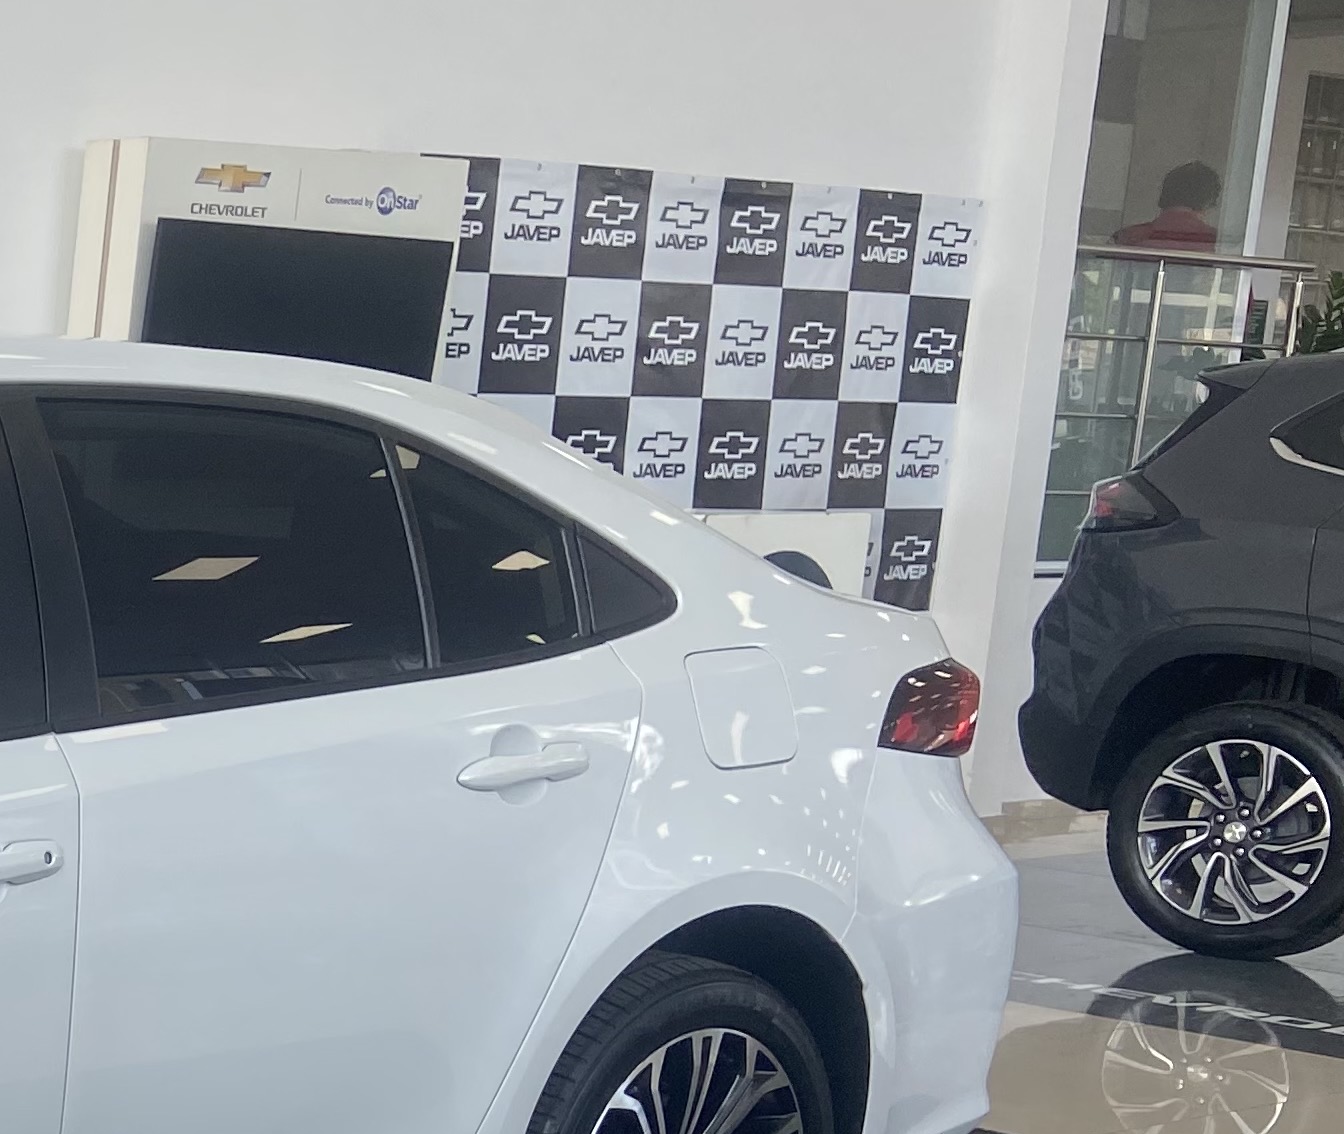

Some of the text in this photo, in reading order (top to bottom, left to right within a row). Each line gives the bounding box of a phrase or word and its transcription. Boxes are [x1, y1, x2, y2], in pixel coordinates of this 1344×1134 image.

[324, 188, 420, 213] Connected by OnStar
[190, 202, 268, 219] CHEVROLET
[503, 223, 561, 242] JAVEP
[580, 227, 637, 247] JAVEP
[655, 233, 707, 250] JAVEP
[726, 237, 778, 256] JAVEP
[795, 242, 845, 259] JAVEP
[861, 246, 909, 264] JAVEP
[922, 251, 967, 267] JAVEP
[490, 343, 550, 362] JAVEP
[569, 346, 625, 363] JAVEP
[642, 348, 698, 366] JAVEP
[714, 351, 766, 367] JAVEP
[783, 352, 835, 370] JAVEP
[850, 355, 895, 371] JAVEP
[908, 357, 955, 374] JAVEP
[632, 463, 685, 479] JAVEP
[703, 462, 758, 480] JAVEP
[773, 463, 822, 479] JAVEP
[837, 463, 883, 480] JAVEP
[895, 464, 940, 479] JAVEP
[883, 563, 928, 581] JAVEP
